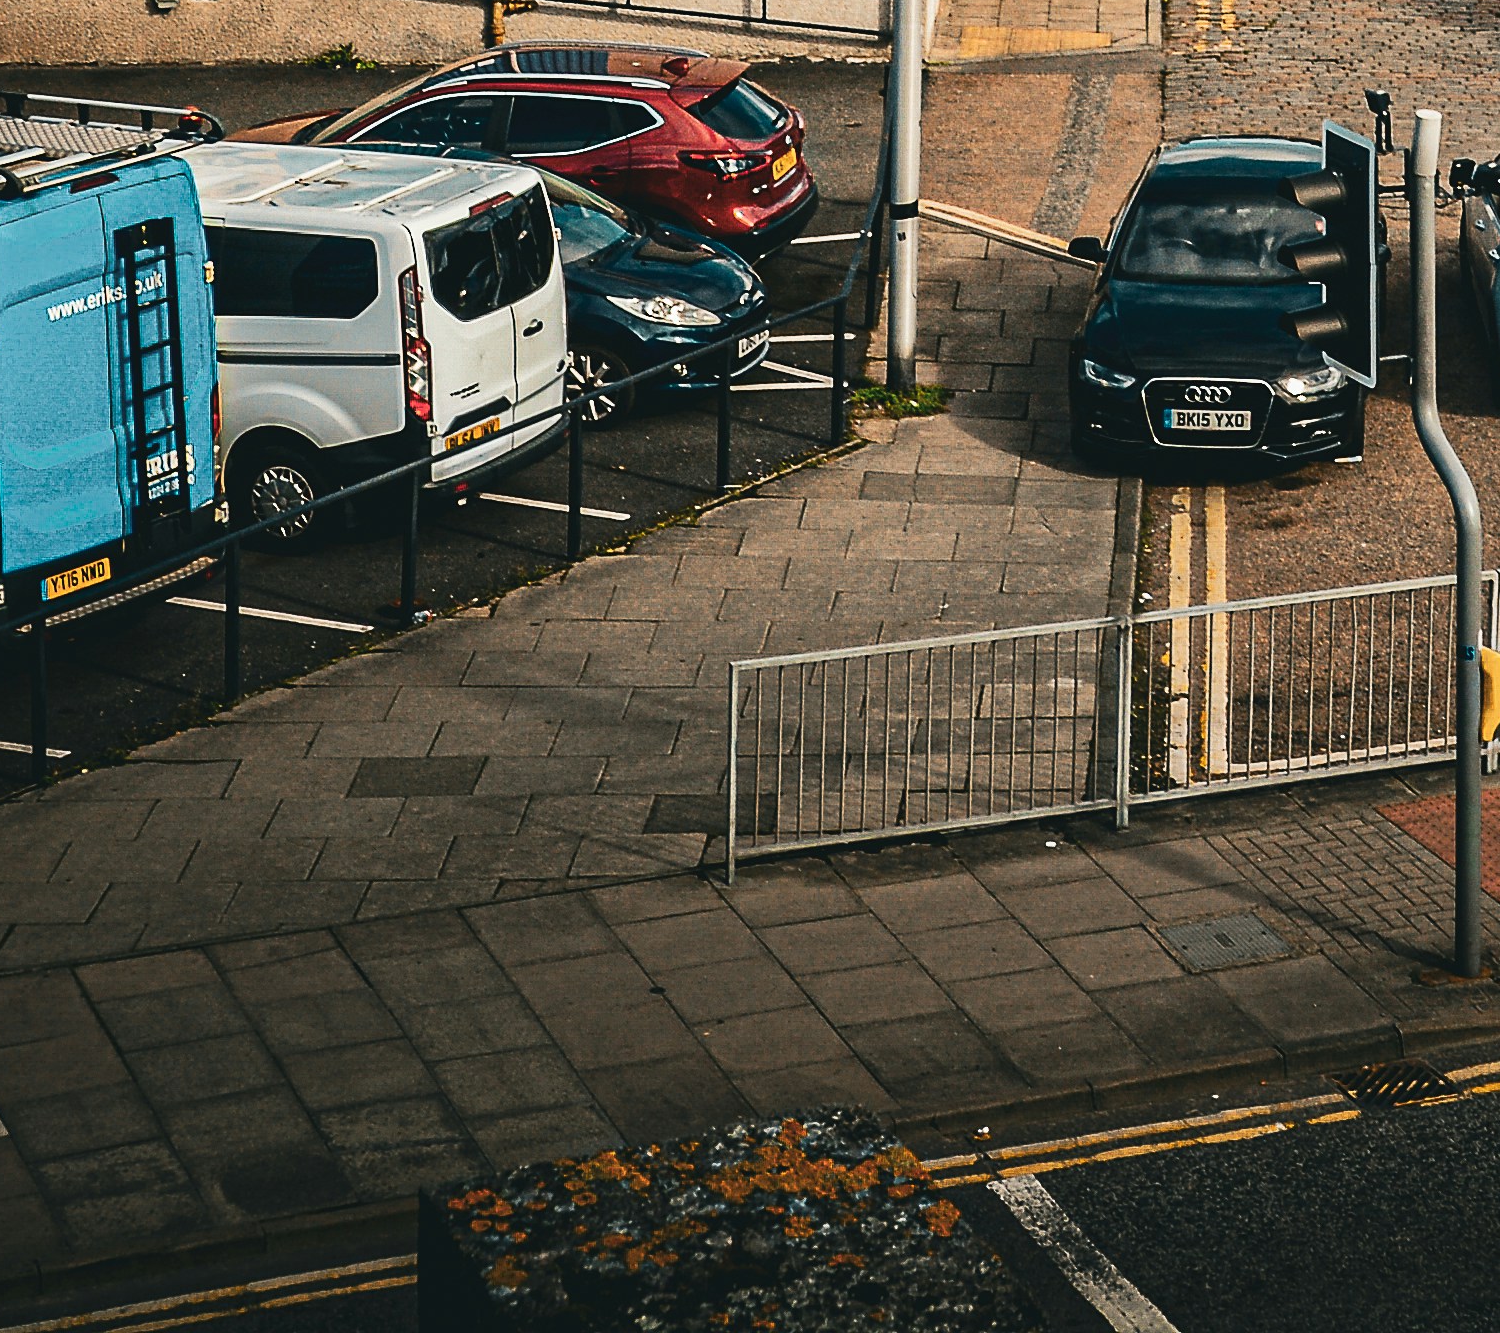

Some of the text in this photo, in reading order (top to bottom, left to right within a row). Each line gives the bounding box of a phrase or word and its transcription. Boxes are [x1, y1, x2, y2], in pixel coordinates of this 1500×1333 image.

[47, 270, 163, 321] www.eriks.o.uk
[1176, 412, 1245, 428] BK15 YXO
[50, 571, 79, 594] YT16
